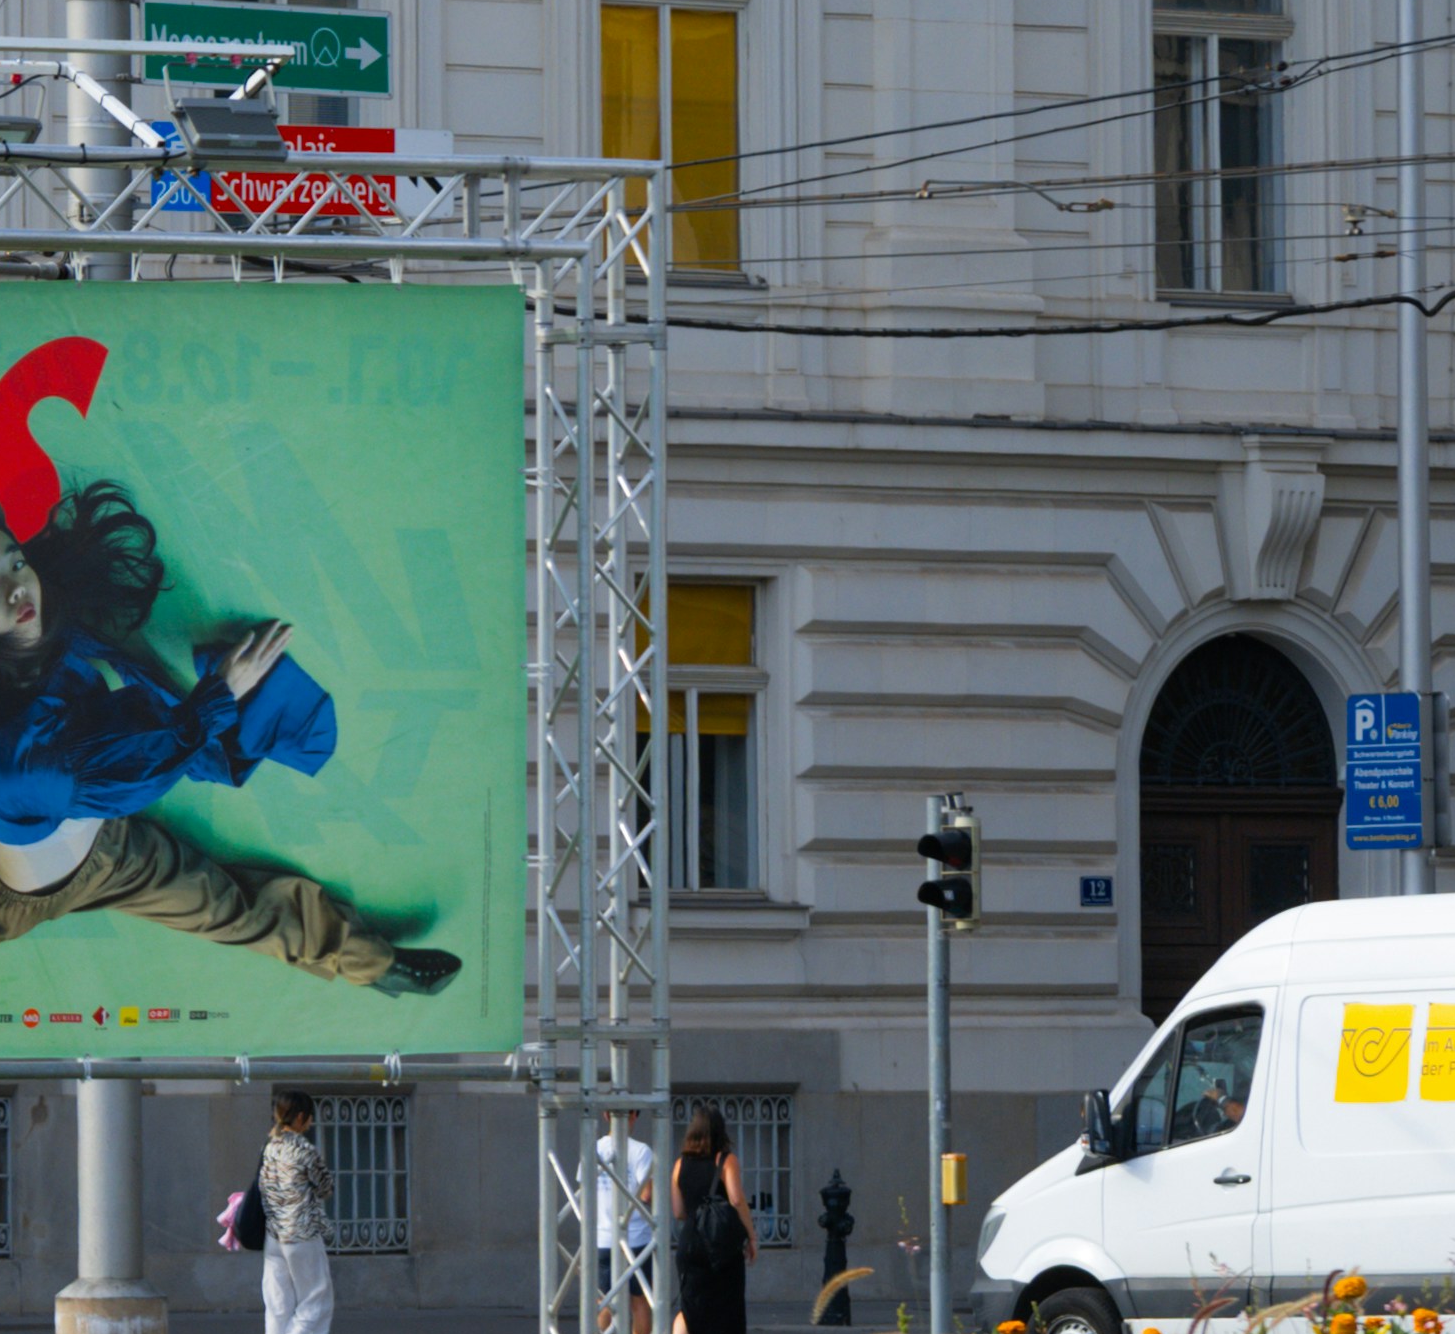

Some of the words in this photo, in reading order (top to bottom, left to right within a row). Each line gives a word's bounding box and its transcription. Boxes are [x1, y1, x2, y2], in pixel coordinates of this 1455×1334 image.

[1355, 708, 1375, 742] P
[1089, 880, 1106, 896] 12
[149, 1009, 169, 1019] ORF
[1421, 1061, 1444, 1076] der
